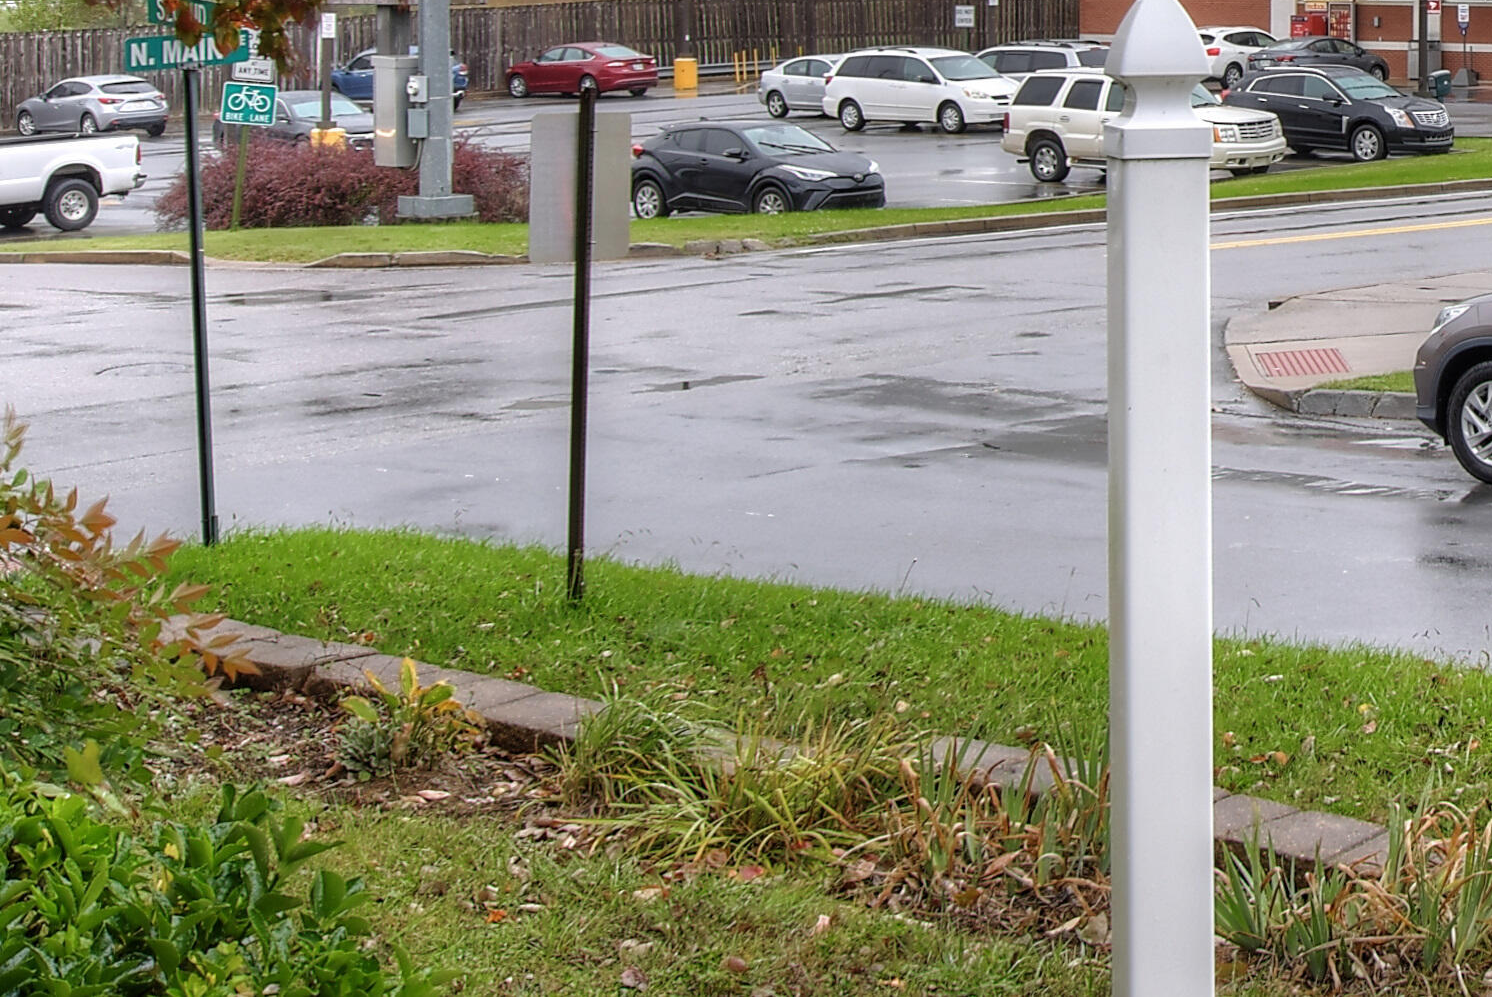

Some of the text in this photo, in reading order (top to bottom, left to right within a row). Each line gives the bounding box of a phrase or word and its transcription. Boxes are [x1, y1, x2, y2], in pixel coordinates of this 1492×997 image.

[130, 42, 155, 67] N.
[162, 36, 223, 65] MAIN
[225, 112, 270, 123] BIKE LANE
